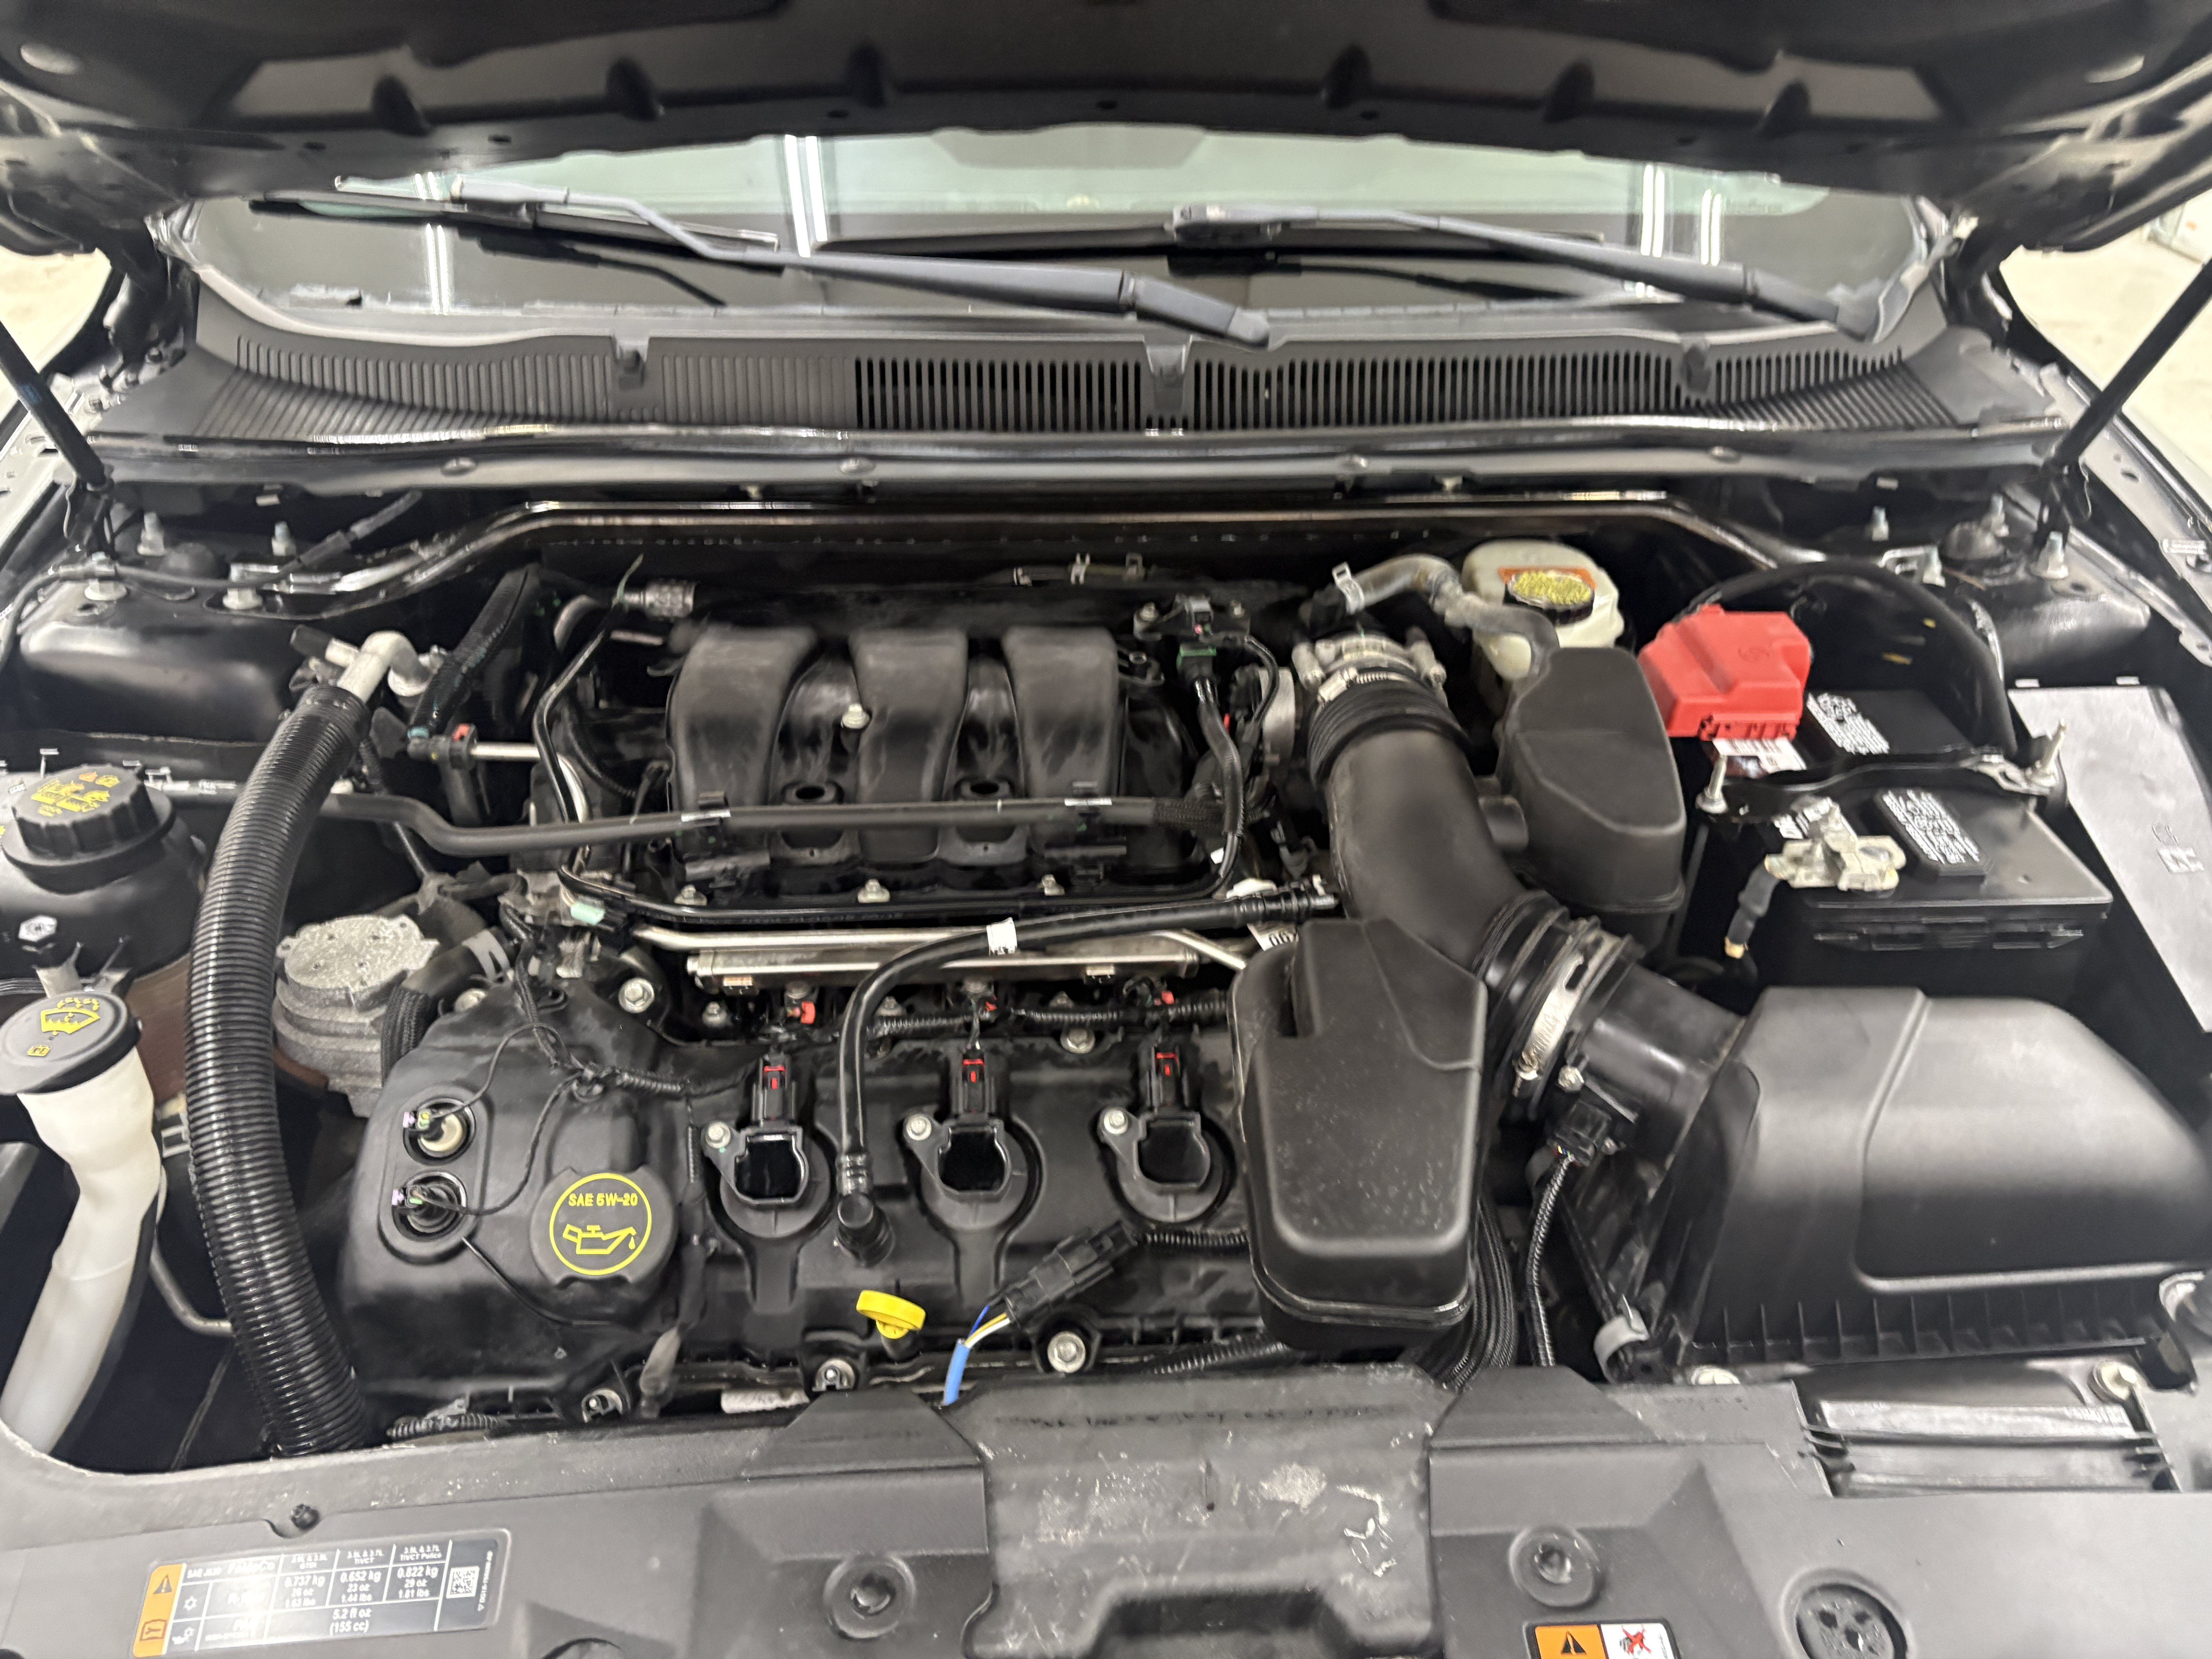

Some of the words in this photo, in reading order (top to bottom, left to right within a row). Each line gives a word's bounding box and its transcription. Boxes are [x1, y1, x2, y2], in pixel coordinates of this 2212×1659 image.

[568, 1193, 593, 1206] SAE
[596, 1193, 638, 1206] 5W-20
[340, 1571, 367, 1583] 0.652
[368, 1570, 381, 1583] kg
[397, 1566, 424, 1578] 0.822
[425, 1565, 439, 1578] kg
[312, 1574, 326, 1587] kg
[404, 1578, 415, 1588] 29
[416, 1578, 428, 1587] oz
[347, 1583, 358, 1593] 23
[359, 1583, 371, 1592] oz
[416, 1588, 430, 1597] lbs
[359, 1593, 372, 1602] lbs
[332, 1609, 349, 1620] 5.2
[359, 1608, 372, 1618] oz
[329, 1621, 352, 1637] (155
[353, 1620, 369, 1633] cc)
